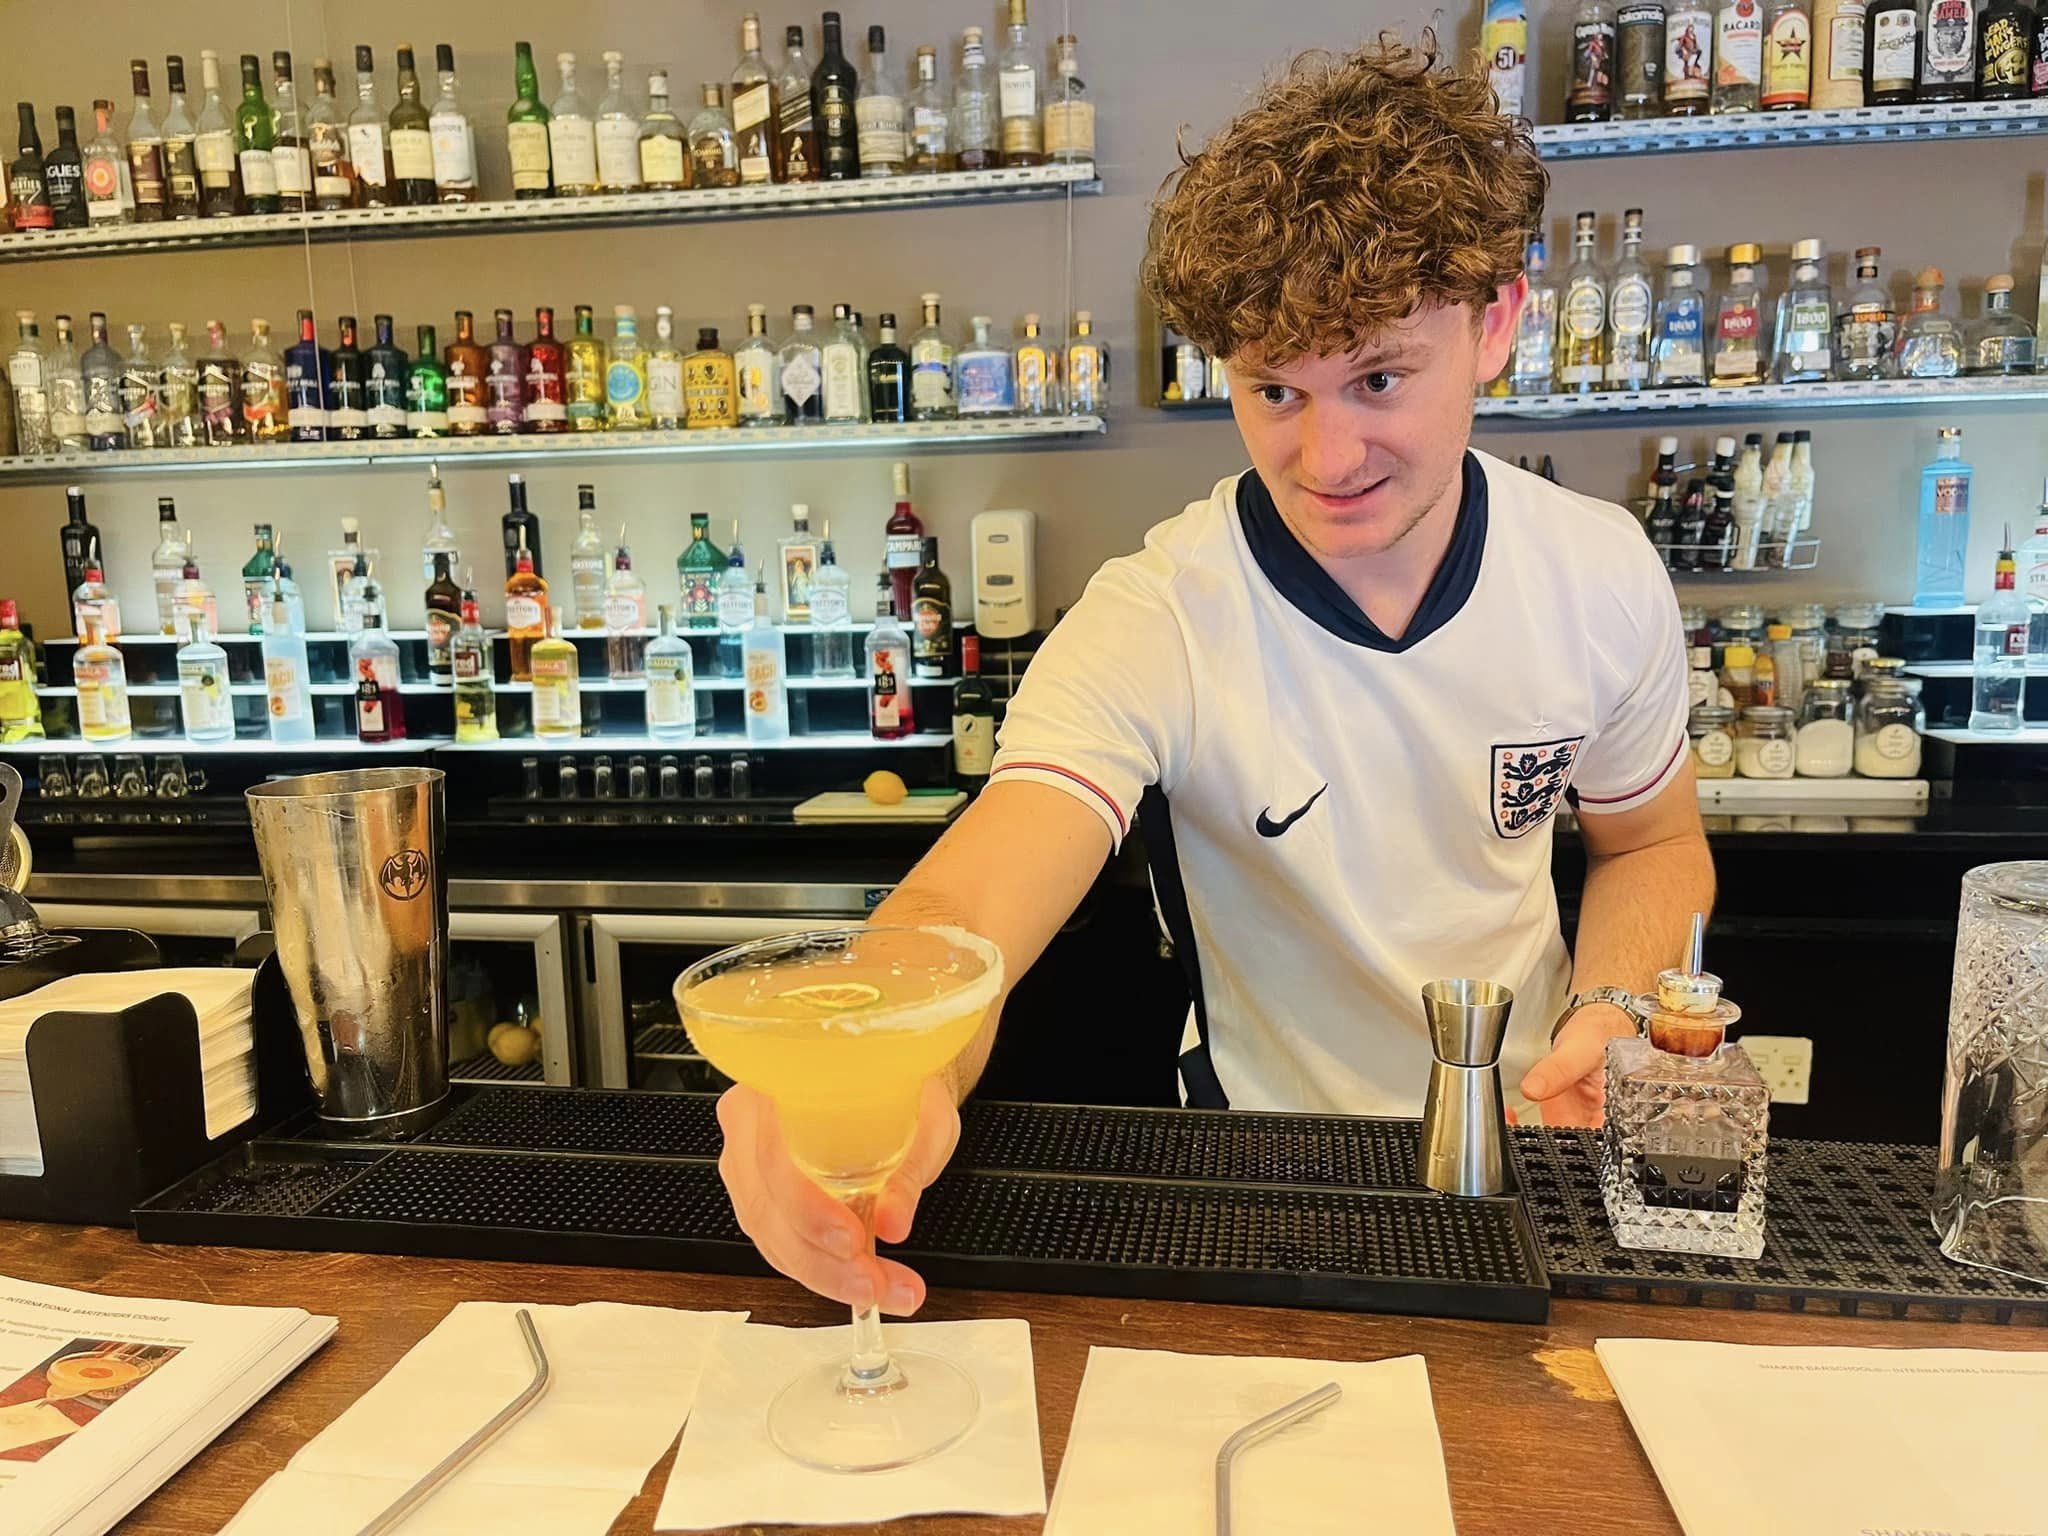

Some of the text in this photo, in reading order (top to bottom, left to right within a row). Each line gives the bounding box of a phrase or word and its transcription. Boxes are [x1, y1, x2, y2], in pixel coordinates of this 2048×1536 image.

[1723, 20, 1760, 32] BACARD
[1498, 48, 1515, 69] 51
[46, 164, 80, 178] GUES
[1796, 312, 1826, 325] 1800
[2029, 574, 2048, 583] STR
[6, 1296, 72, 1313] INTERNATIONAL
